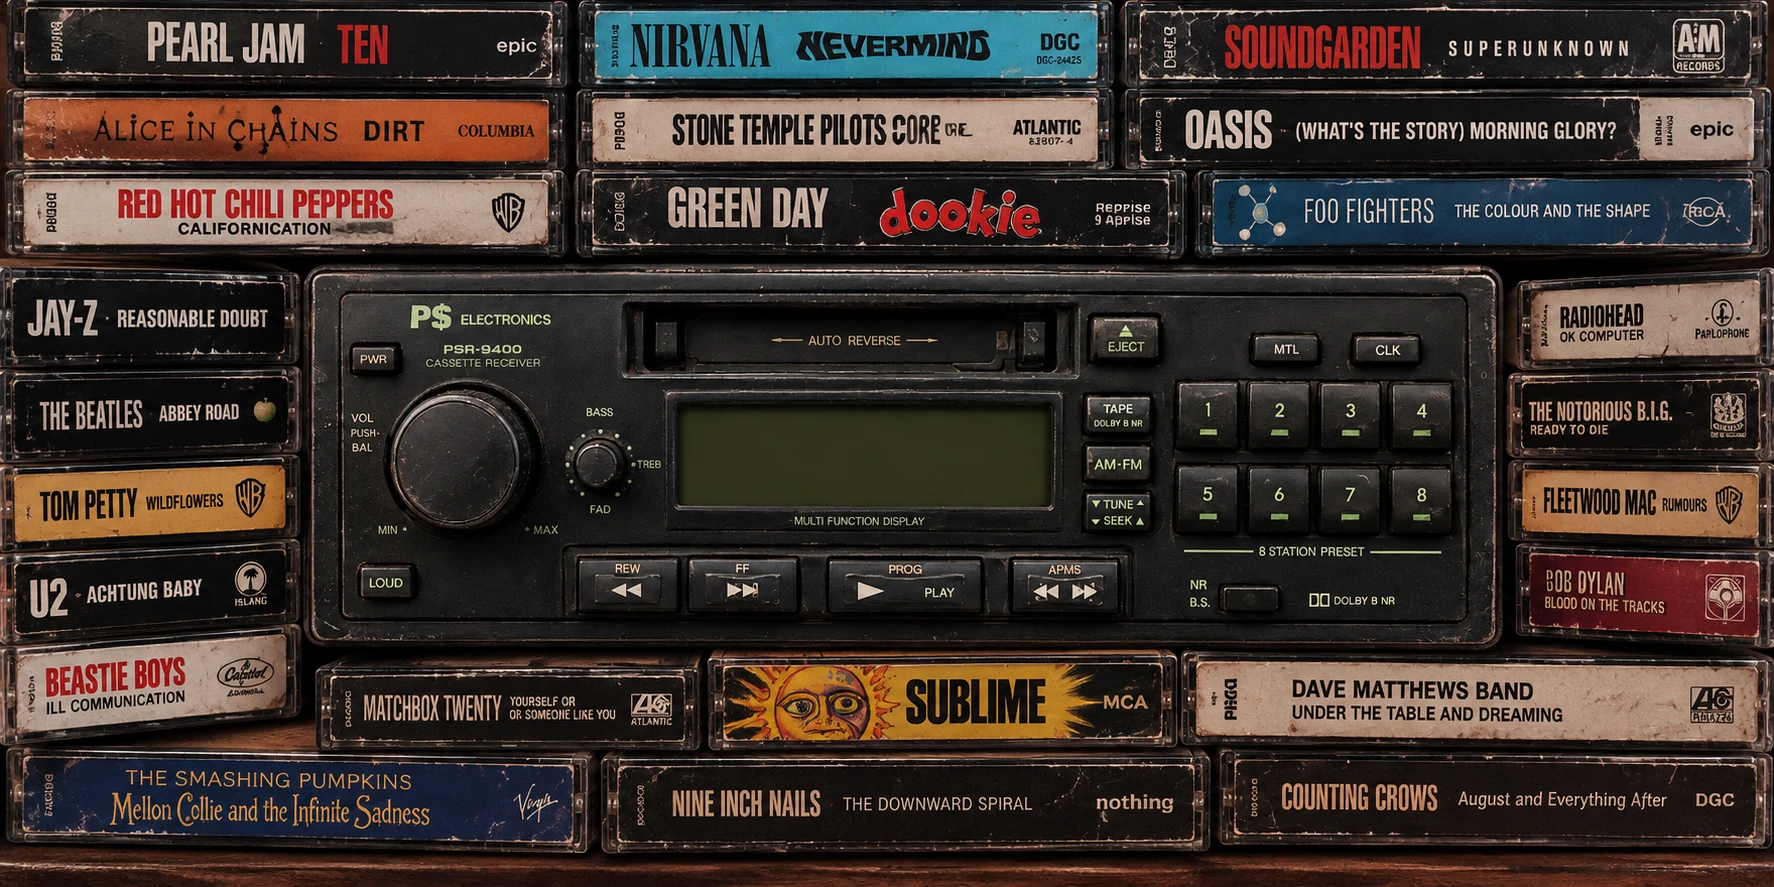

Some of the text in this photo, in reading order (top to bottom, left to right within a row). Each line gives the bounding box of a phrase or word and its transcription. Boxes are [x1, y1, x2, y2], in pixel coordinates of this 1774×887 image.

[148, 21, 388, 64] PEARL JAM TEN
[497, 38, 536, 55] epic
[630, 24, 771, 67] NIRVANA
[796, 30, 990, 61] NEVERMIND
[1041, 33, 1080, 50] DGC
[1225, 24, 1628, 69] SOUNDGARDEN SUPERUNKNOWN
[94, 106, 424, 155] ALICE IN CHAINS DIRT
[458, 125, 534, 137] COLUMBIA
[673, 114, 734, 145] STONE
[740, 114, 814, 145] TEMPLE
[821, 114, 887, 145] PILOTS
[1013, 120, 1081, 135] ATLANTIC
[1186, 109, 1616, 149] OASIS (WHAT'S THE STORY) MORNING GLORY?
[118, 189, 396, 221] RED HOT CHILI PEPPERS
[668, 186, 761, 228] GREEN
[773, 188, 829, 228] DAY
[1305, 198, 1650, 223] FOO FIGHTERS THE COLOUR AND THE SHAPE
[880, 187, 1042, 239] dookie
[178, 223, 331, 235] CALIFORNICATION
[28, 299, 268, 336] JAY-Z REASONABLE DOUBT
[461, 314, 551, 325] ELECTRONICS
[1560, 303, 1643, 328] RADIOHEAD
[808, 335, 901, 346] AUTO REVERSE
[1560, 330, 1644, 342] OK COMPUTER
[444, 345, 521, 354] PSR-9400
[1109, 342, 1144, 352] EJECT
[1275, 344, 1299, 354] MTL
[1376, 345, 1400, 355] CLK
[361, 355, 386, 363] PWR
[426, 359, 540, 367] CASSETTE RECEIVER
[40, 400, 239, 430] THE BEATLES ABBEY ROAD
[586, 408, 613, 416] BASS
[1103, 404, 1133, 413] TAPE
[1275, 403, 1284, 417] 2
[1346, 404, 1355, 417] 3
[1417, 404, 1427, 418] 4
[1529, 401, 1672, 421] THE NOTORIOUS B.I.G.
[351, 413, 373, 422] VOL
[1531, 424, 1608, 435] READY TO DIE
[352, 443, 372, 452] BAL
[637, 460, 661, 468] TREB
[1203, 487, 1212, 501] 5
[1275, 487, 1284, 501] 6
[1346, 487, 1355, 502] 7
[1417, 488, 1426, 502] 8
[1544, 487, 1620, 515] FLEETWOOD
[1625, 489, 1656, 515] MAC
[1663, 498, 1707, 512] RUMOURS
[40, 491, 79, 521] TOM
[85, 488, 137, 519] PETTY
[146, 493, 223, 510] WILDFLOWERS
[590, 505, 611, 514] FAD
[1103, 500, 1133, 509] TUNE
[795, 516, 925, 526] MULTI FUNCTION DISPLAY
[1104, 516, 1132, 525] SEEK
[378, 525, 397, 534] MIN
[534, 525, 558, 534] MAX
[1259, 546, 1364, 557] 8 STATION PRESET
[615, 564, 640, 574] REW
[889, 565, 922, 574] PROG
[1048, 565, 1081, 575] APMS
[370, 578, 403, 588] LOUD
[1578, 571, 1624, 595] DYLAN
[30, 578, 202, 618] U2 ACHTUNG BABY
[925, 588, 954, 597] PLAY
[1545, 596, 1664, 613] BLOOD ON THE TRACKS
[45, 660, 128, 697] BEASTIE
[135, 657, 185, 689] BOYS
[1293, 680, 1533, 700] DAVE MATTHEWS BAND
[47, 690, 186, 714] ILL COMMUNICATION
[364, 695, 439, 721] MATCHBOX
[443, 695, 502, 721] TWENTY
[510, 696, 575, 706] YOURSELF OR
[906, 679, 1046, 724] SUBLIME
[1104, 695, 1148, 709] MCA
[510, 709, 615, 720] OR SOMEONE LIKE YOU
[1293, 705, 1562, 722] UNDER THE TABLE AND DREAMING
[126, 770, 411, 790] THE SMASHING PUMPKINS
[673, 790, 1032, 817] NINE INCH NAILS THE DOWNWARD SPIRAL
[1096, 793, 1175, 813] nothing
[1282, 783, 1667, 811] COUNTING CROWS August and Everything After
[1696, 793, 1734, 806] DGC
[110, 792, 430, 829] Mellon Collie and the Infinite Sadness
